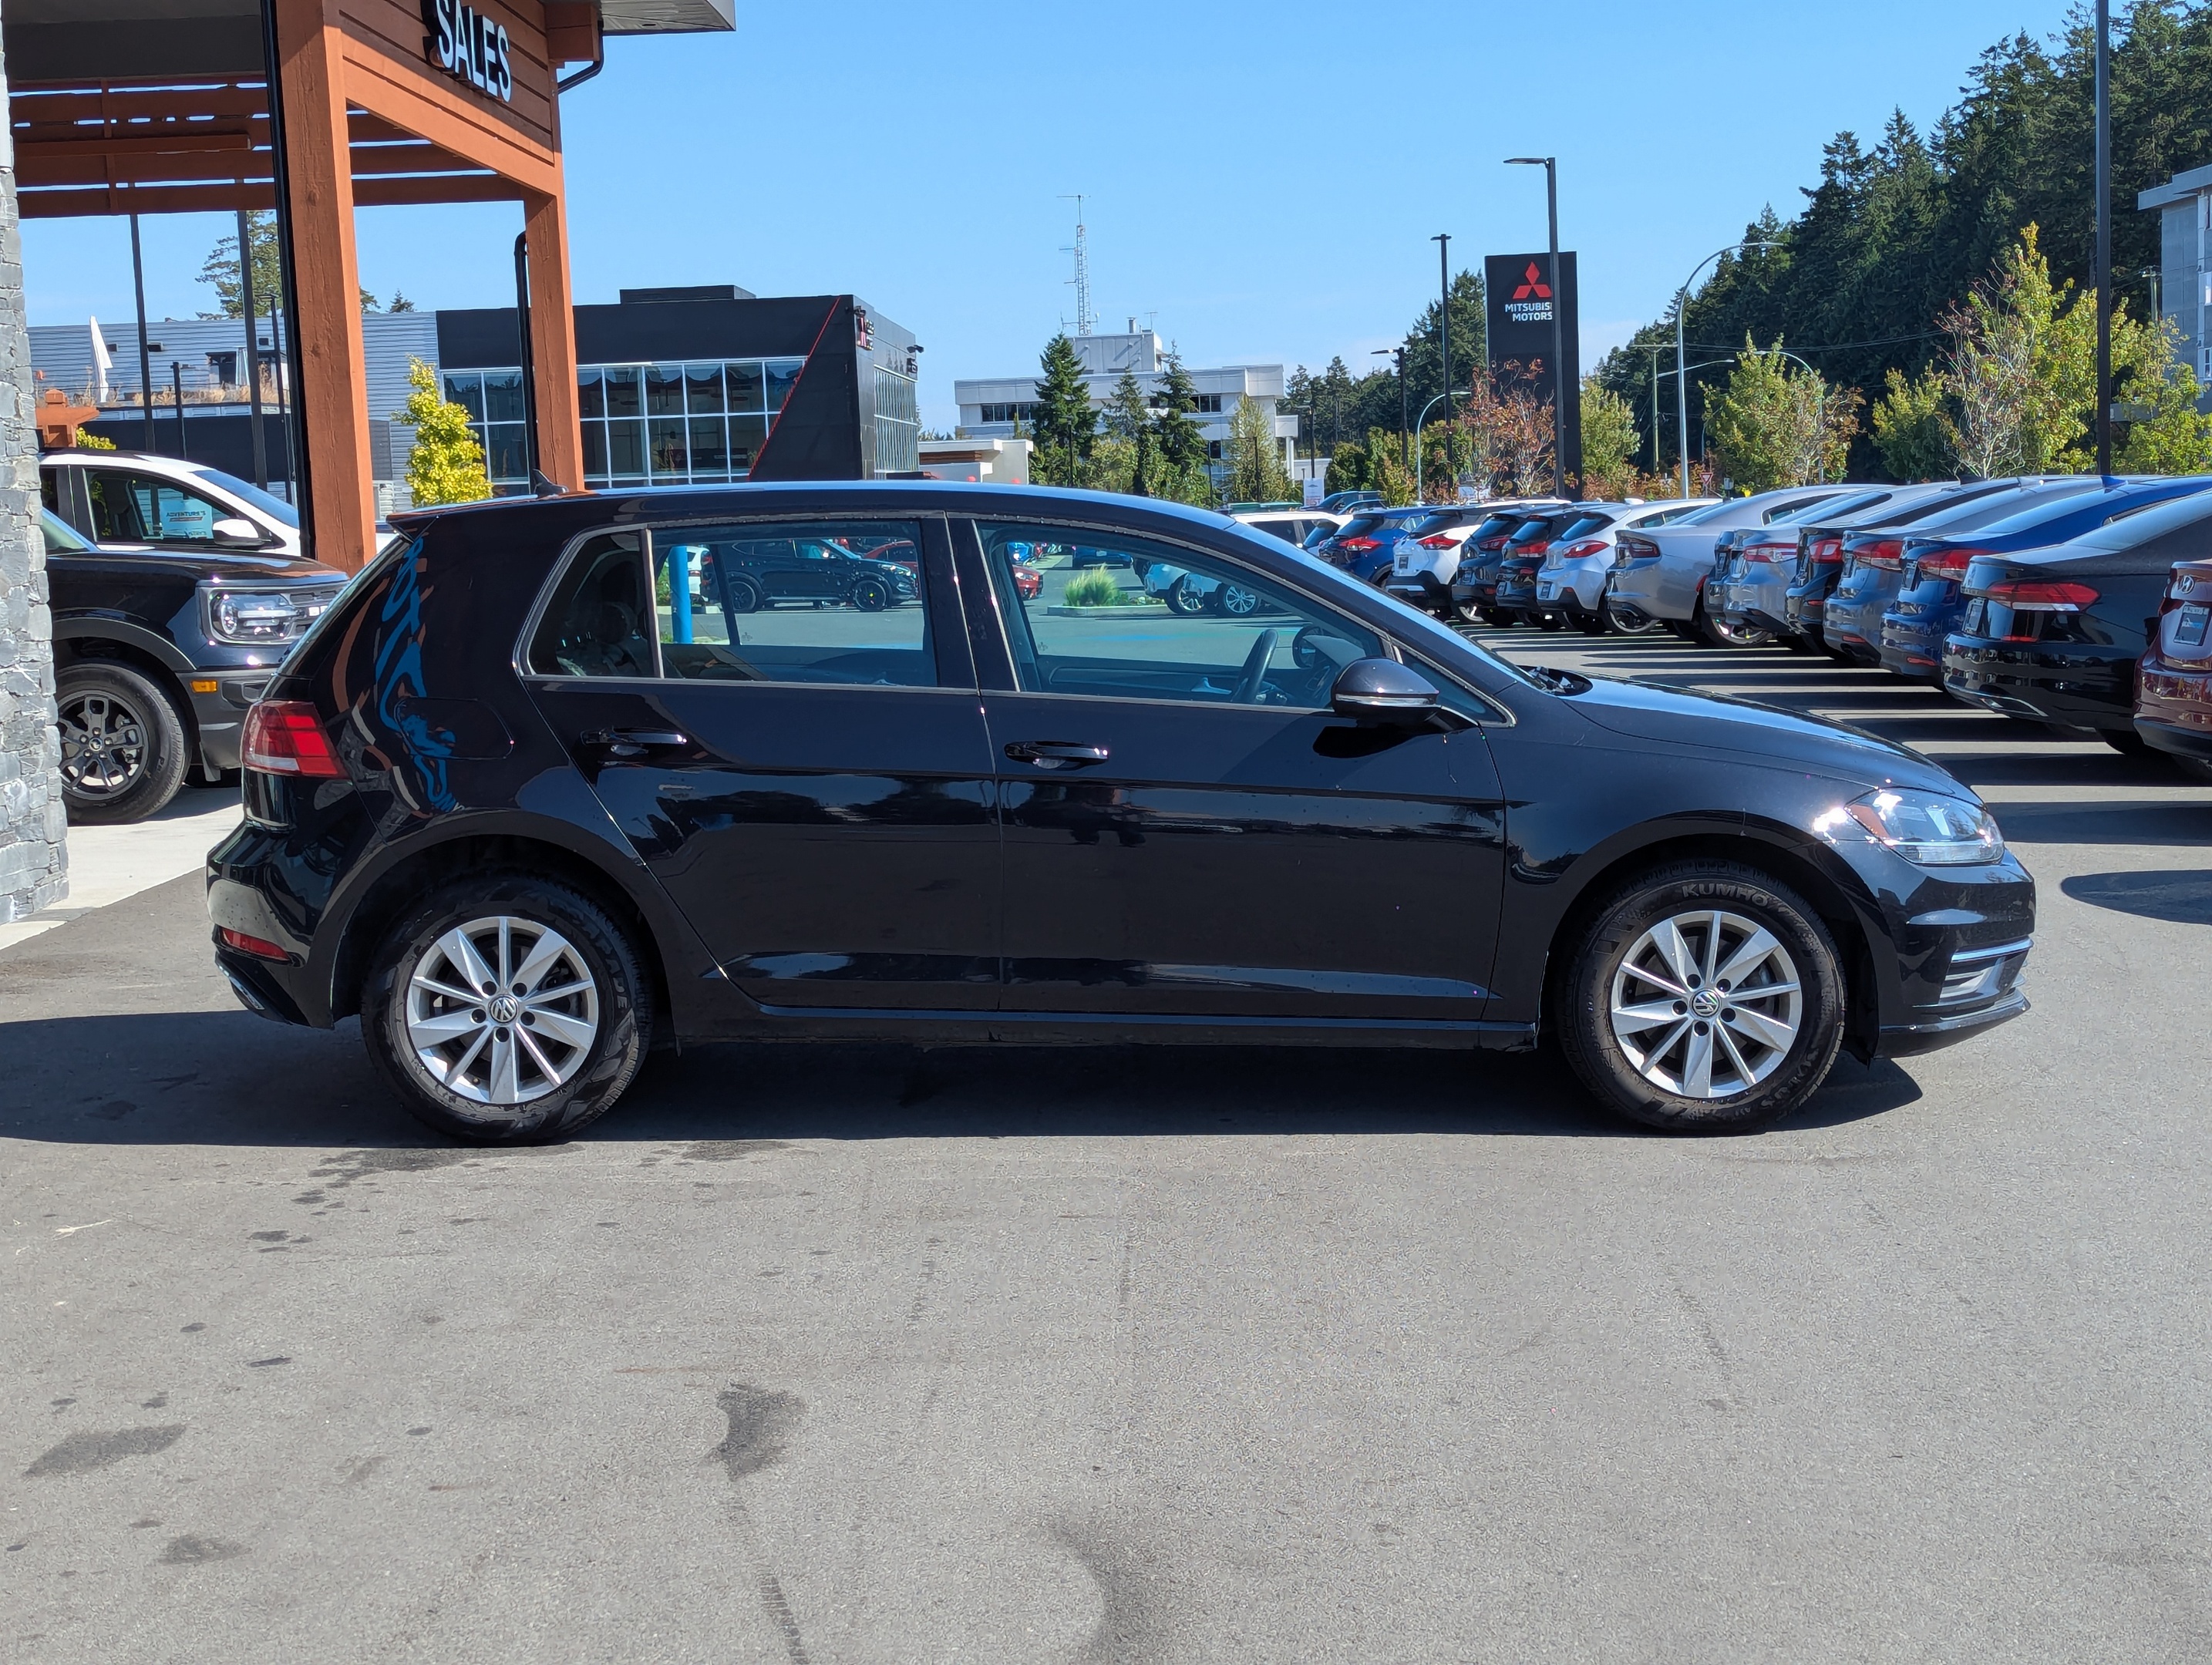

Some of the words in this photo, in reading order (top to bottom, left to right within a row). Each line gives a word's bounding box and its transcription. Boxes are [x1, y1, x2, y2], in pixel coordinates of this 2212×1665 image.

[436, 0, 511, 102] SALES
[1513, 311, 1552, 321] MOTORS
[1682, 883, 1768, 906] KUMHO
